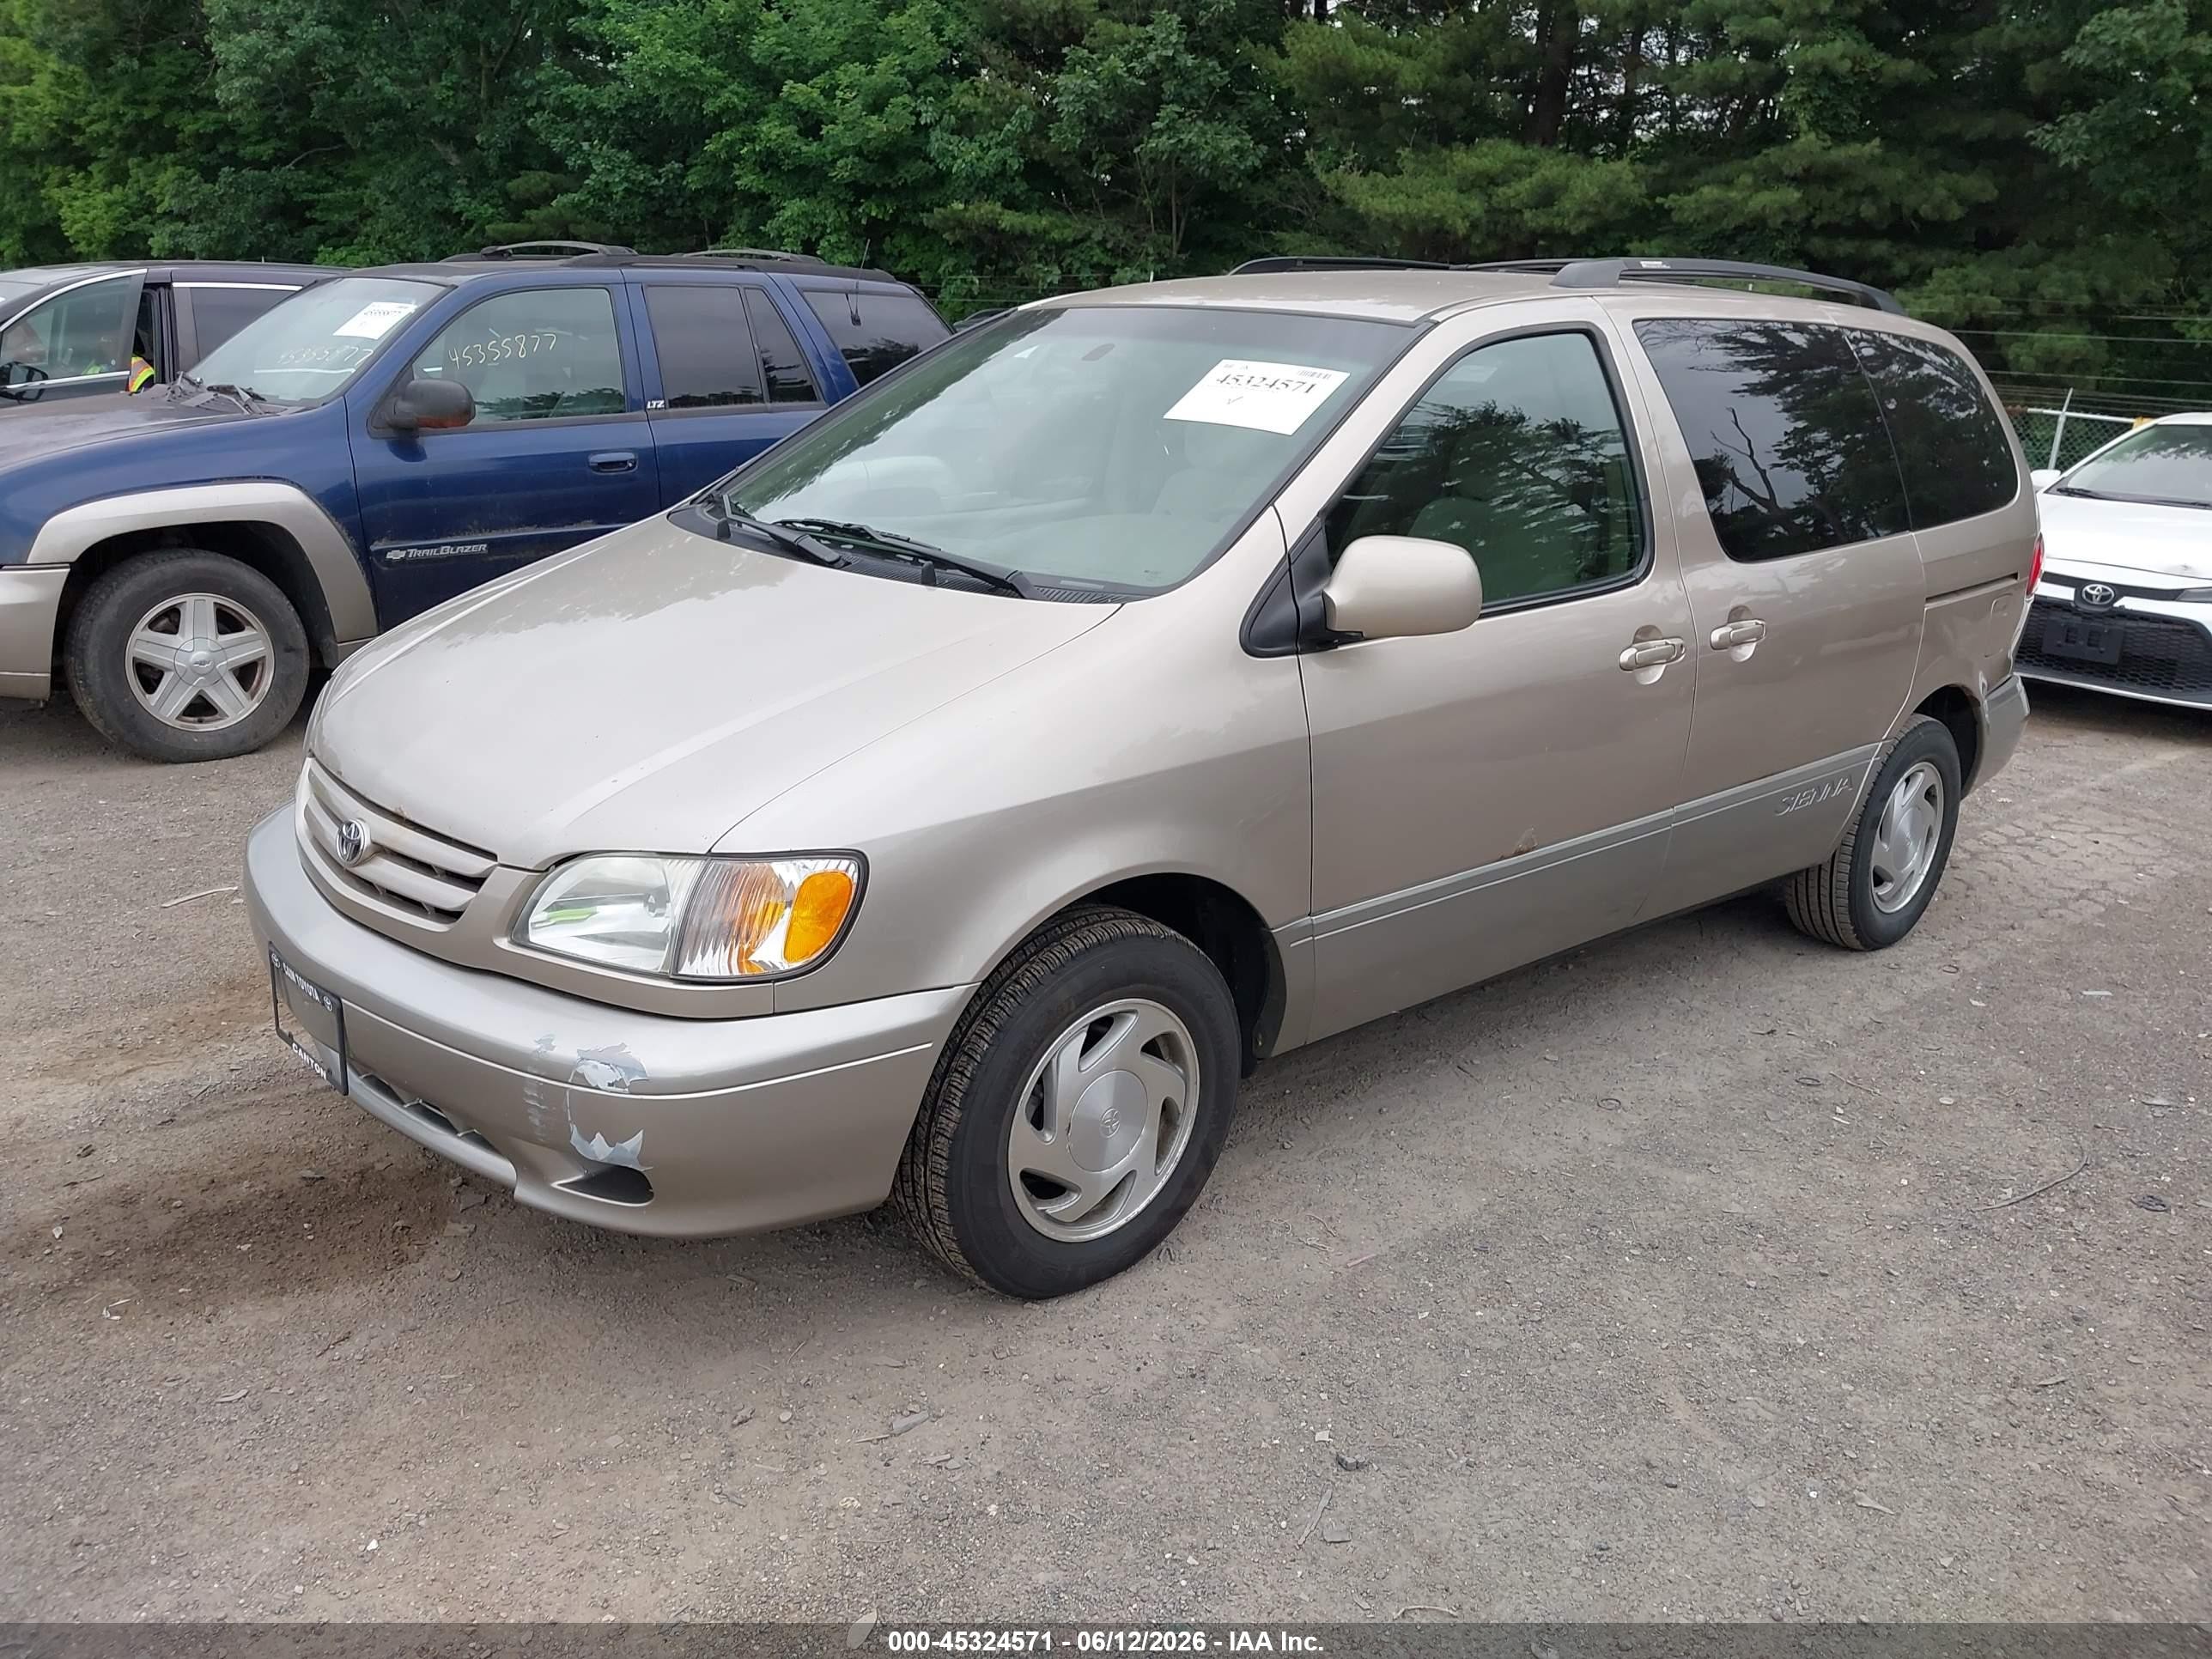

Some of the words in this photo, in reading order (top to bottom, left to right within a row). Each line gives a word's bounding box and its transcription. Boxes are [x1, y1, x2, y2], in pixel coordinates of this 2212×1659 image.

[448, 333, 556, 370] 45355877
[1216, 374, 1316, 394] 45324571
[647, 399, 665, 409] LTZ
[1774, 775, 1853, 817] SIENNA
[295, 973, 320, 1003] TOYOTA
[292, 1042, 326, 1080] CANTON
